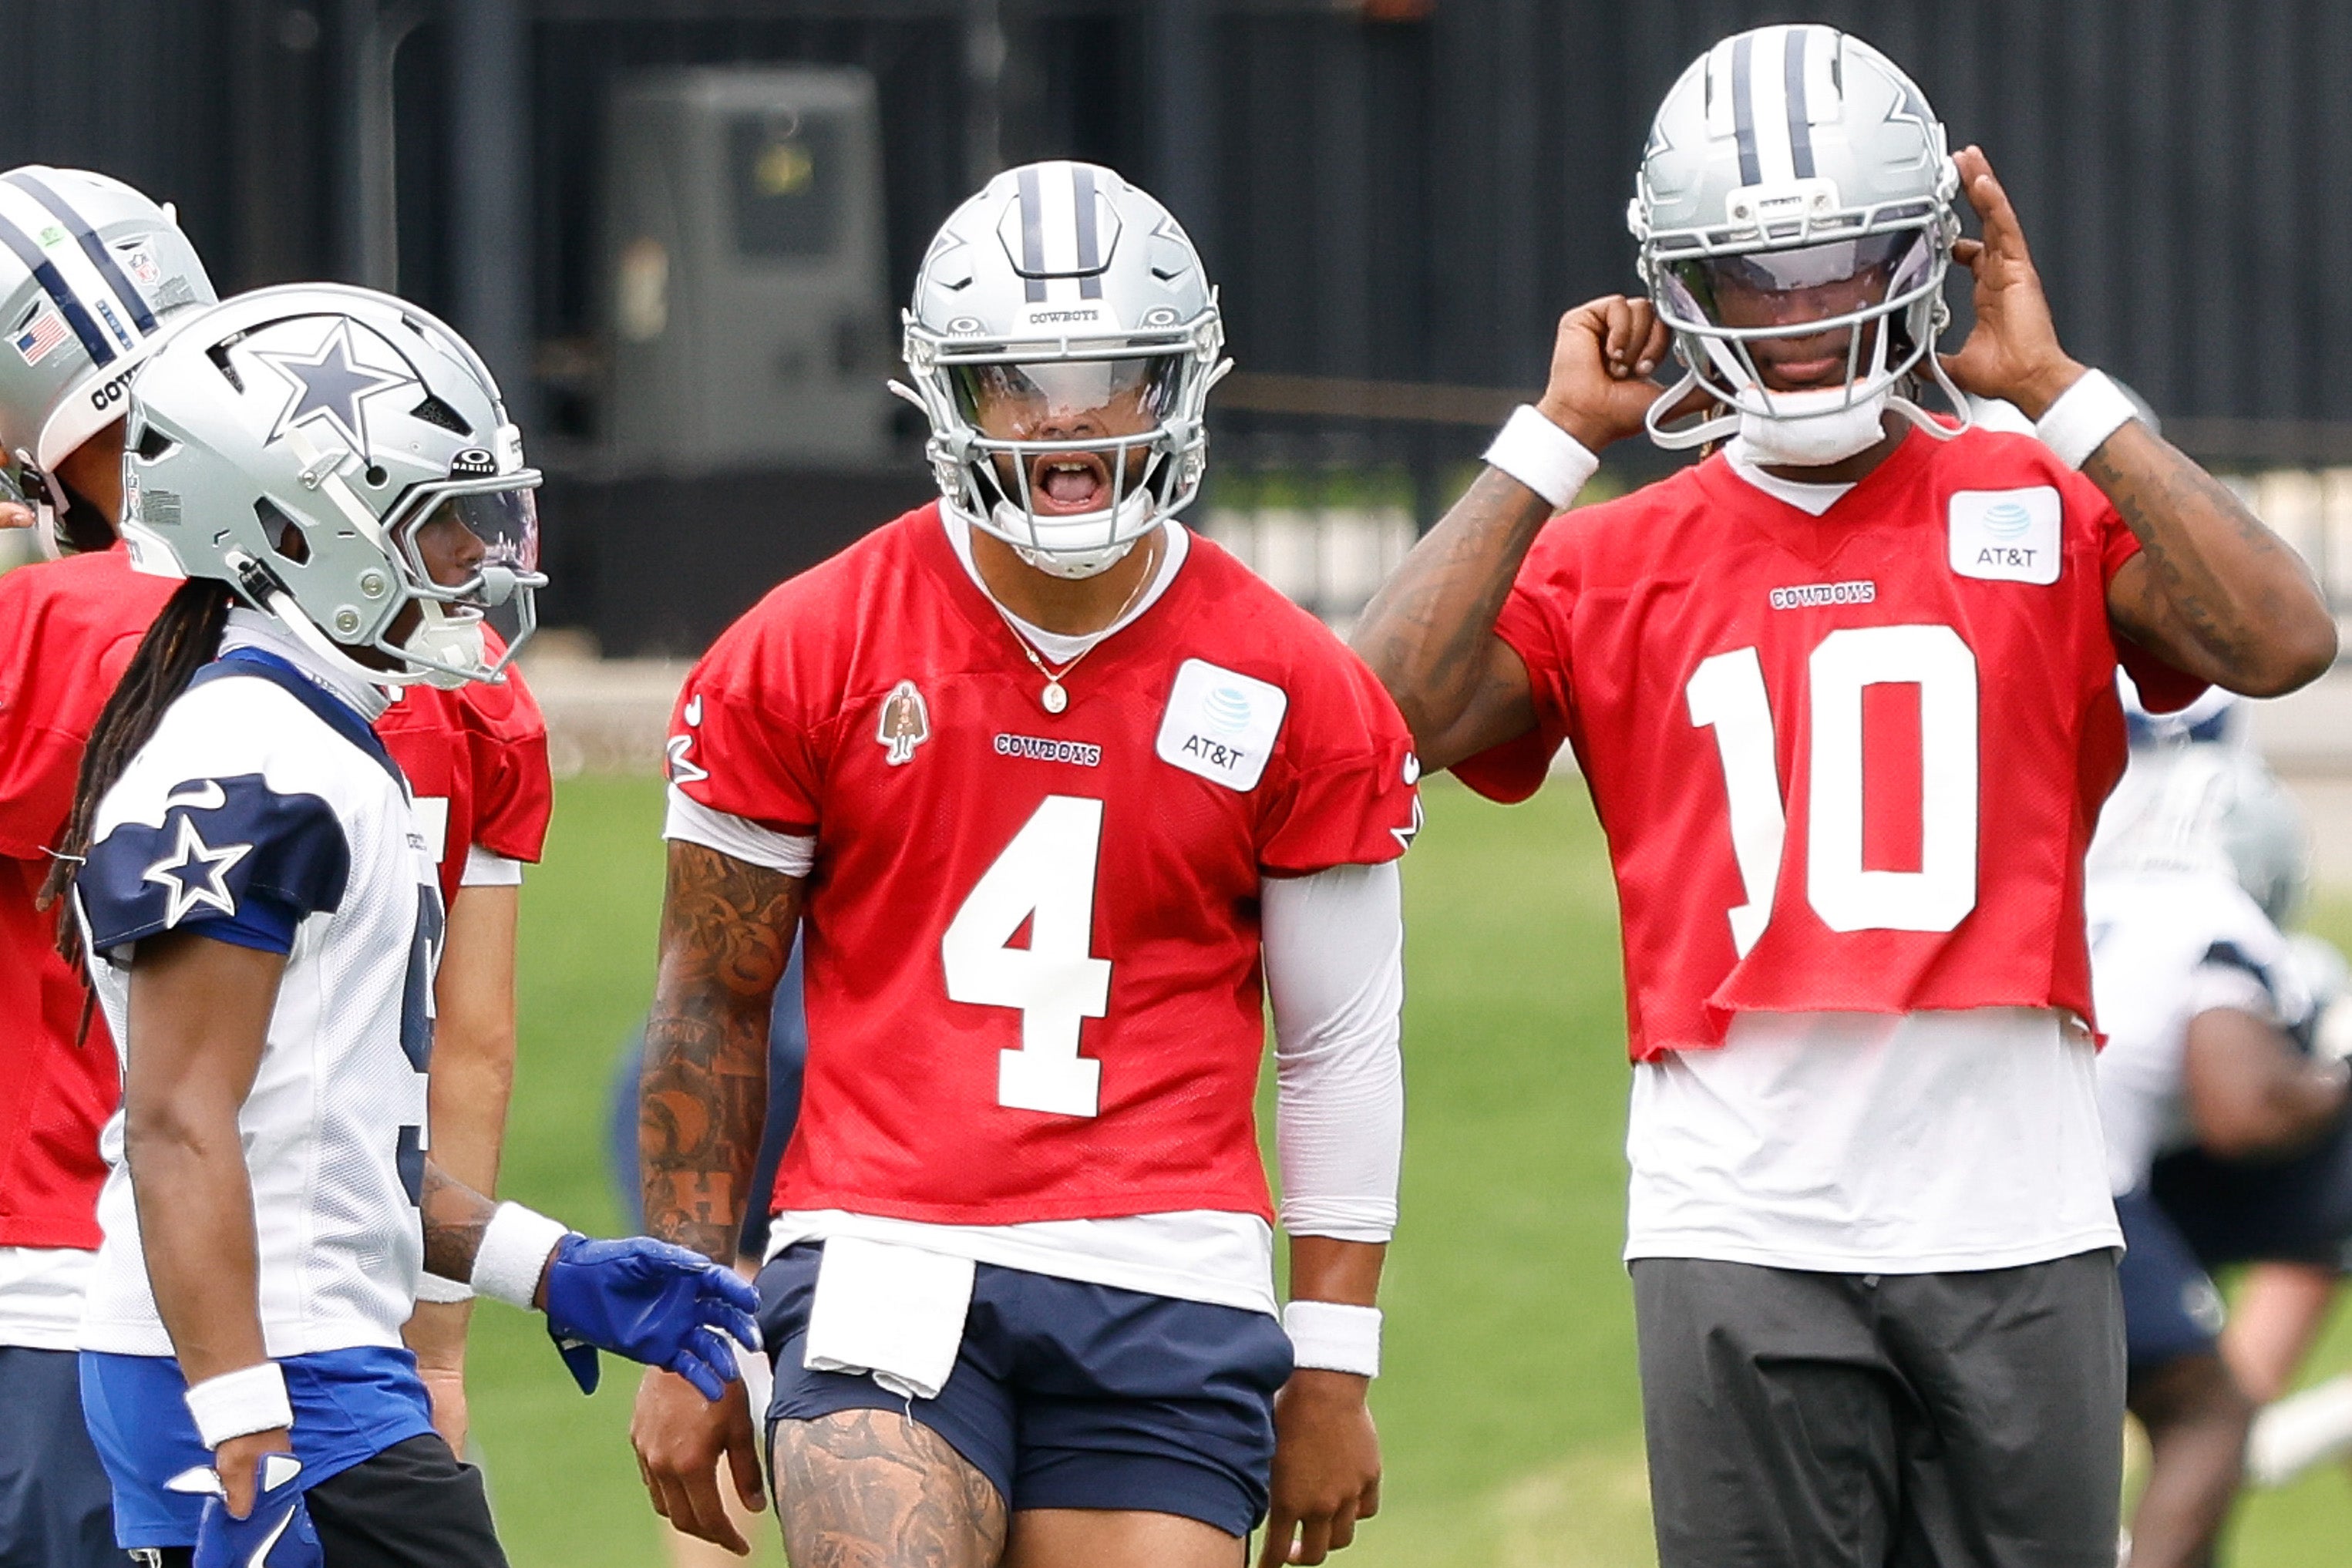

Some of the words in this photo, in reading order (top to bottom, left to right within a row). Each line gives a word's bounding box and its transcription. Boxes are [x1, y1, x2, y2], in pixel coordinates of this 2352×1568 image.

[1029, 309, 1099, 324] COWBOYS
[1977, 547, 2037, 568] AT&T
[1770, 580, 1876, 610] COWBOYS
[994, 733, 1102, 767] COWBOYS
[1181, 734, 1245, 770] AT&T
[1685, 624, 1979, 961] 10
[941, 795, 1112, 1118] 4
